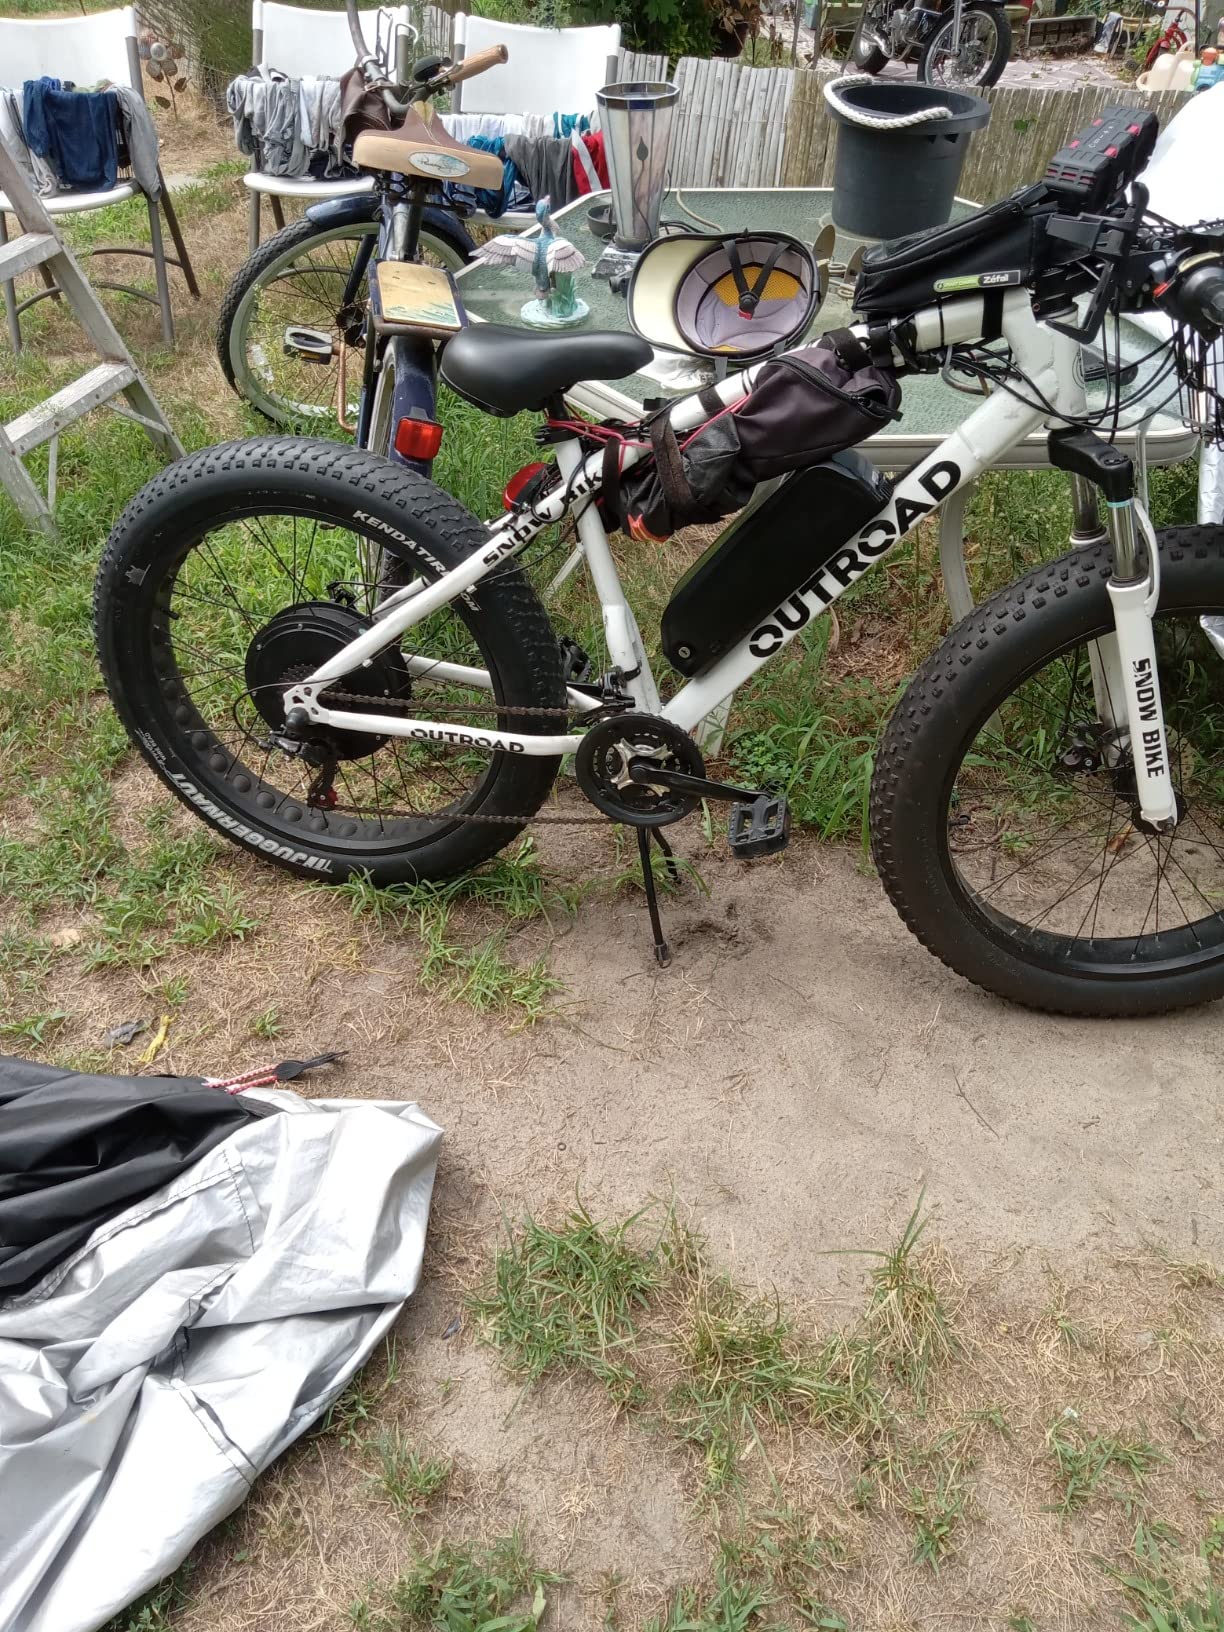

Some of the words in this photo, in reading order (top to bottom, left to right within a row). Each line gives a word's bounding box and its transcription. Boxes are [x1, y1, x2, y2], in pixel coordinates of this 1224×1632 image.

[983, 273, 1009, 284] Zéfal
[482, 507, 552, 567] SNOW
[560, 472, 602, 505] BIK
[749, 460, 961, 658] OUTROAD
[1132, 657, 1158, 721] SNOW
[410, 728, 525, 753] OUTROAD
[1142, 728, 1164, 778] BIKE
[168, 773, 308, 865] JUGGERNAUT
